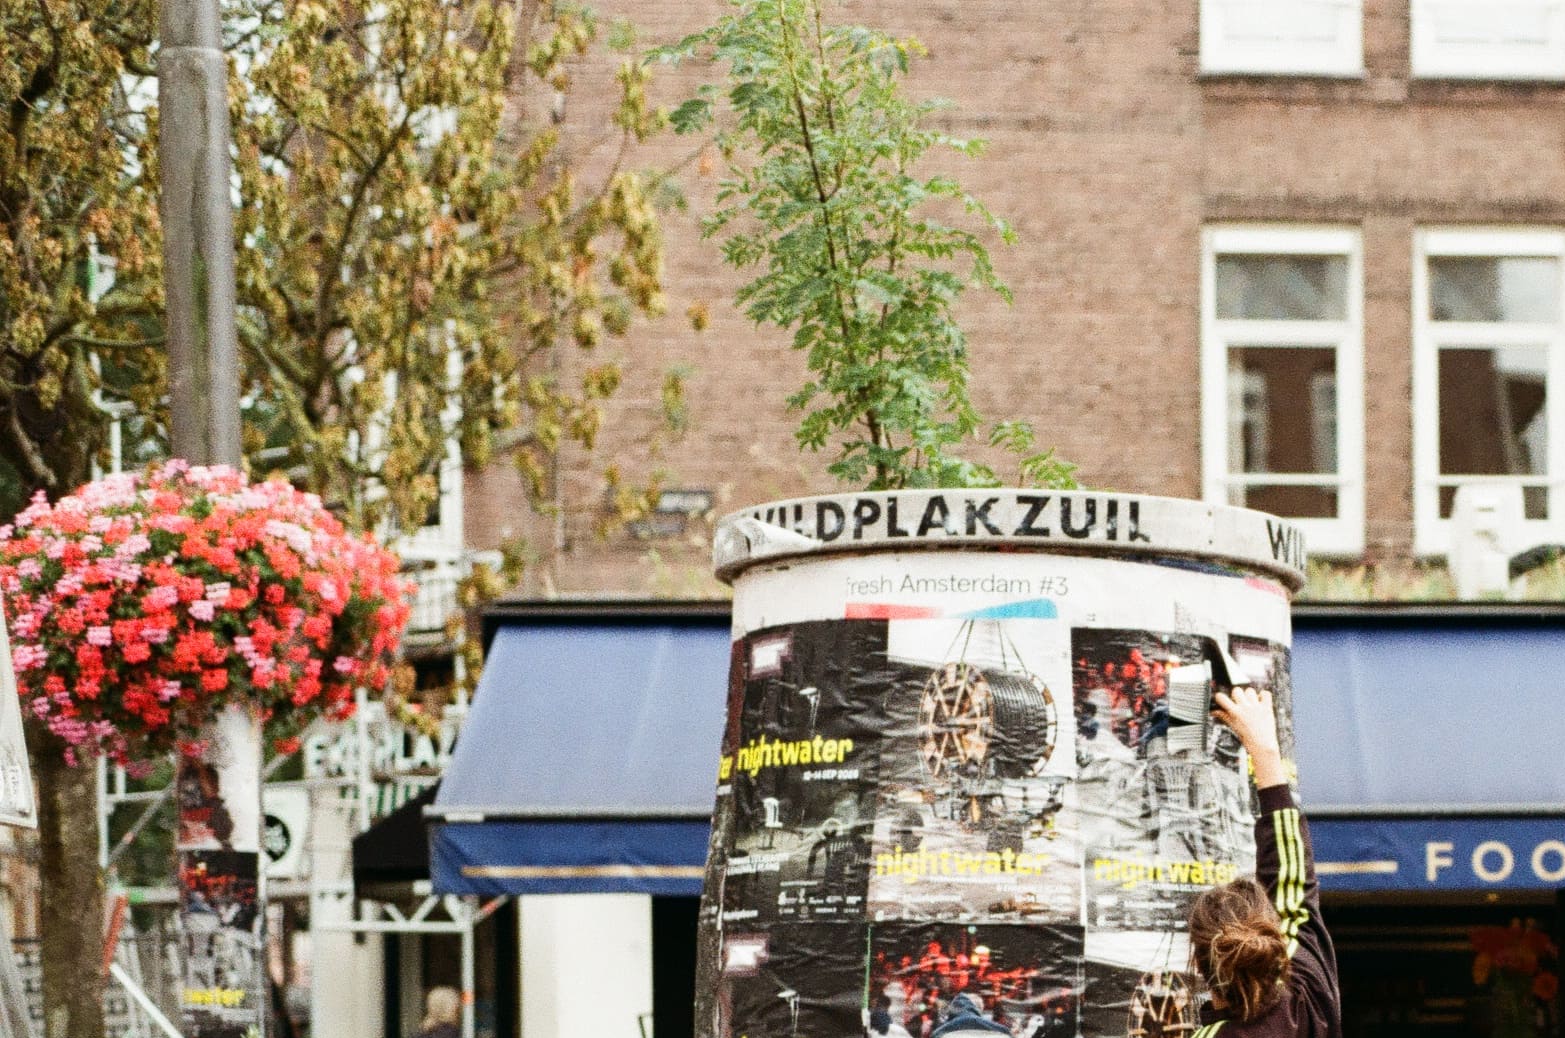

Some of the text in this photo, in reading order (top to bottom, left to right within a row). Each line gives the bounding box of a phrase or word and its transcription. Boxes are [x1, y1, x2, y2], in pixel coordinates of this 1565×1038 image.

[900, 573, 1030, 594] Amsterdam
[1040, 575, 1070, 597] #3
[736, 734, 854, 778] nightwater
[876, 839, 1051, 885] nightwater
